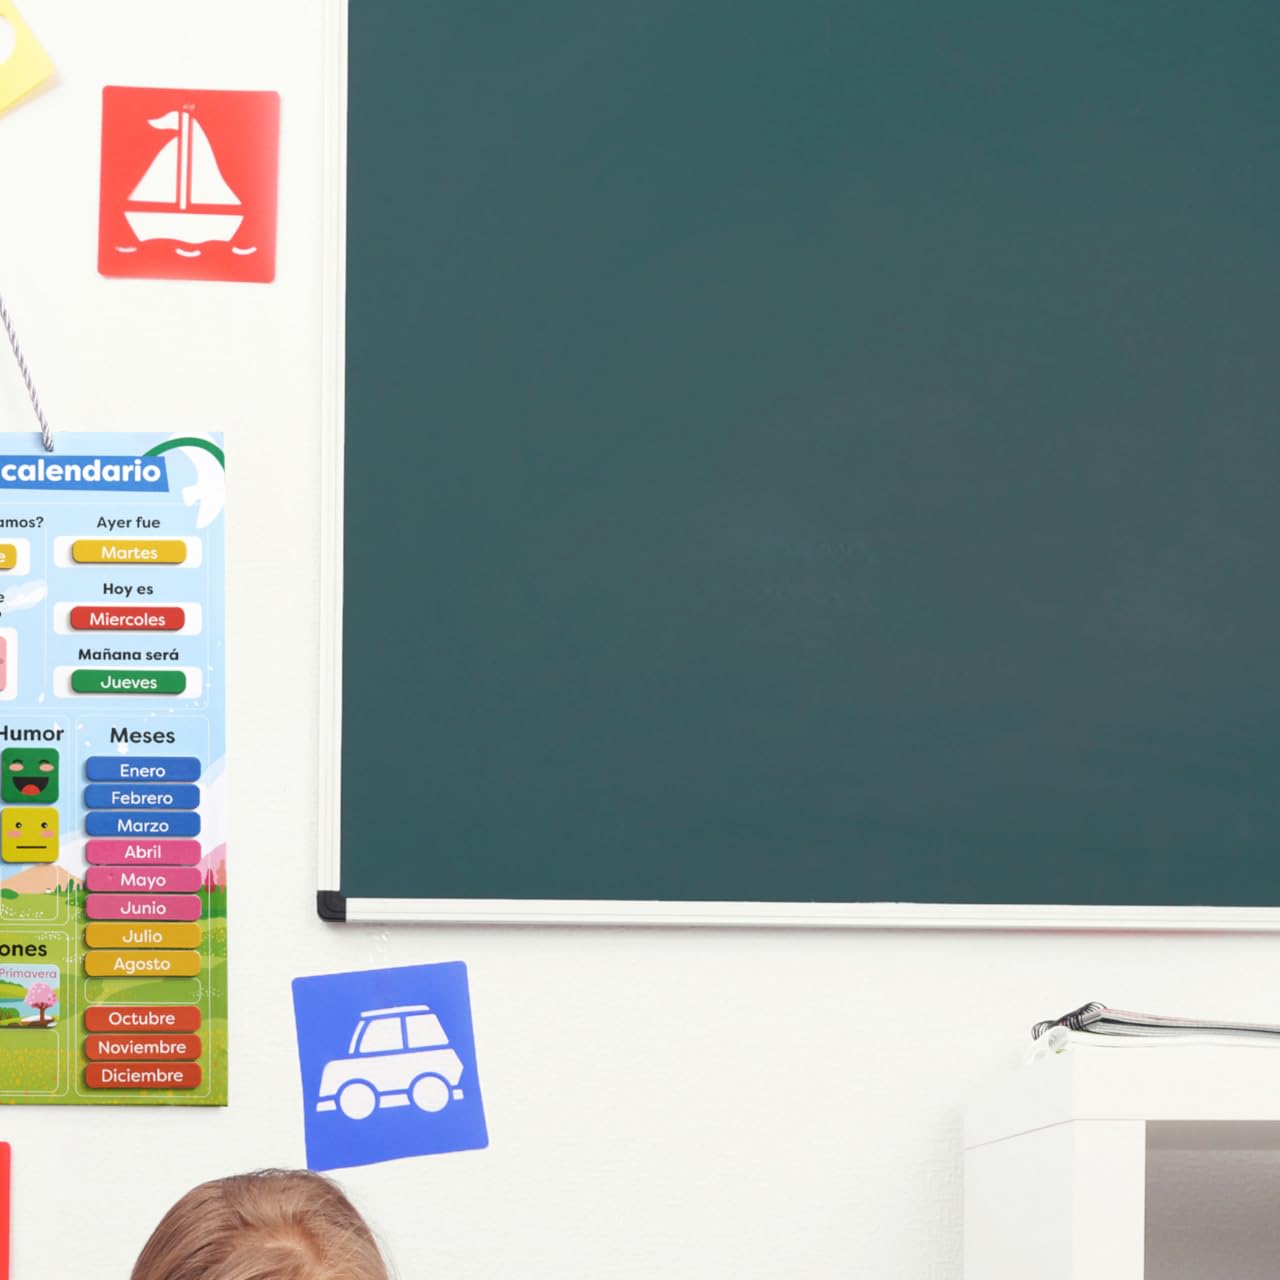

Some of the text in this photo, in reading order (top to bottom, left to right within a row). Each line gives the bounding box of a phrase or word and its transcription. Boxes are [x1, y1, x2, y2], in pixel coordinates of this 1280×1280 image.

[1, 458, 161, 482] calendario
[97, 517, 160, 531] Ayer fue
[101, 546, 158, 560] Martes
[103, 583, 154, 599] Hoy es
[90, 613, 166, 627] Miercoles
[78, 648, 179, 662] Mañana será
[100, 676, 157, 690] Jueves
[111, 728, 175, 743] Meses
[120, 764, 165, 778] Enero
[111, 790, 173, 805] Febrero
[118, 819, 169, 833] Marzo
[125, 844, 161, 859] Abril
[121, 874, 166, 890] Mayo
[120, 901, 167, 915] Junio
[123, 929, 163, 944] Julio
[114, 957, 170, 973] Agosto
[0, 968, 57, 979] Primavera
[108, 1011, 175, 1026] Octubre
[98, 1040, 187, 1055] Noviembre
[101, 1068, 183, 1083] Diciembre
